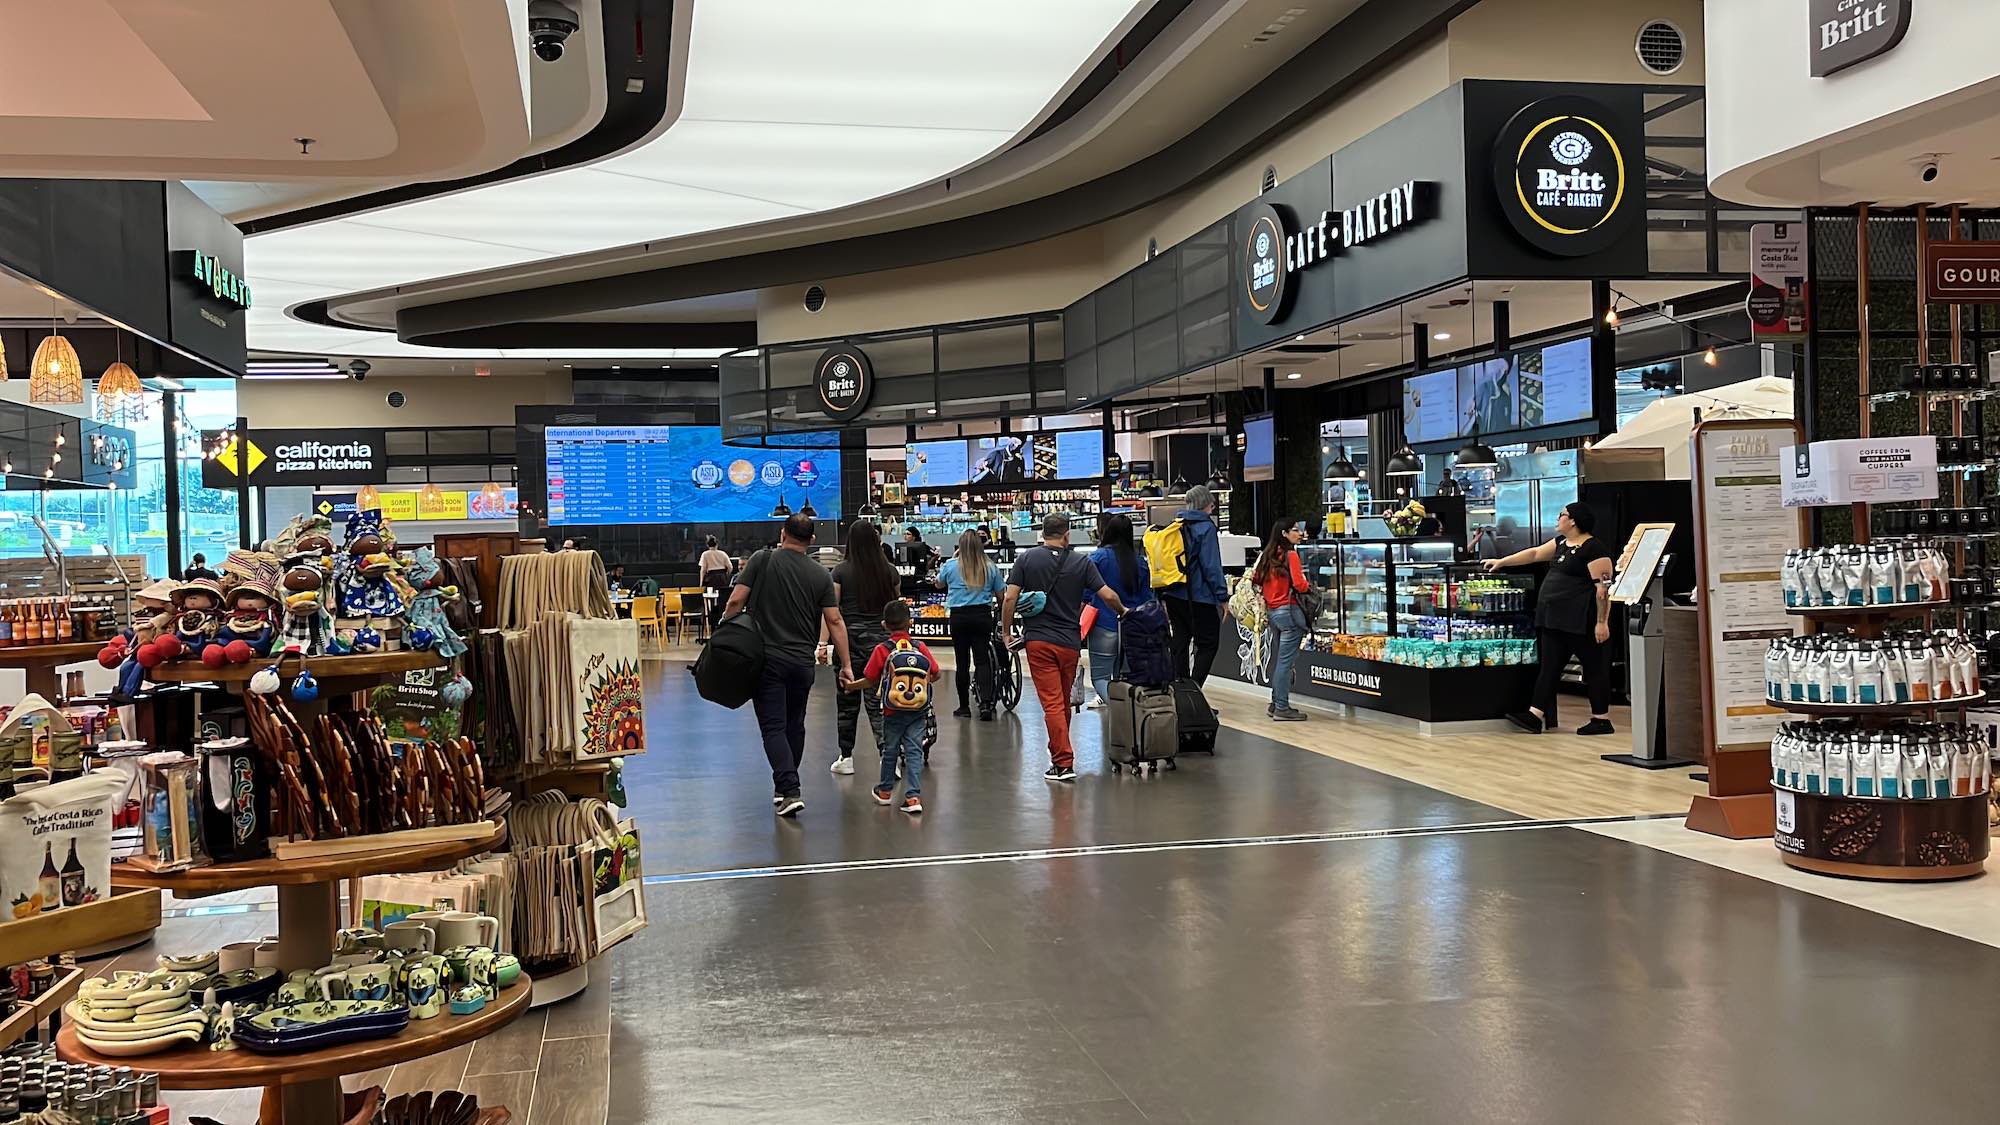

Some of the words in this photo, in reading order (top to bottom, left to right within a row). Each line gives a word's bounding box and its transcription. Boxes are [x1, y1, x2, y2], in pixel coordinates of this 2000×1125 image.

[1820, 2, 1887, 51] Britt
[1537, 168, 1606, 191] Britt
[1536, 190, 1560, 206] CAFÉ
[1567, 193, 1603, 207] BAKERY
[1286, 211, 1328, 273] CAFÉ
[1343, 180, 1415, 248] BAKERY
[1253, 257, 1275, 279] Britt
[829, 378, 856, 391] Britt
[546, 428, 594, 437] International
[595, 428, 636, 438] Departures
[275, 440, 372, 458] california
[276, 458, 316, 472] pizza
[318, 457, 373, 470] kitchen
[909, 623, 944, 635] FRESH
[1311, 665, 1332, 681] FRESH
[1333, 669, 1356, 685] BAKED
[1358, 673, 1380, 689] DAILY
[54, 811, 80, 821] Costa
